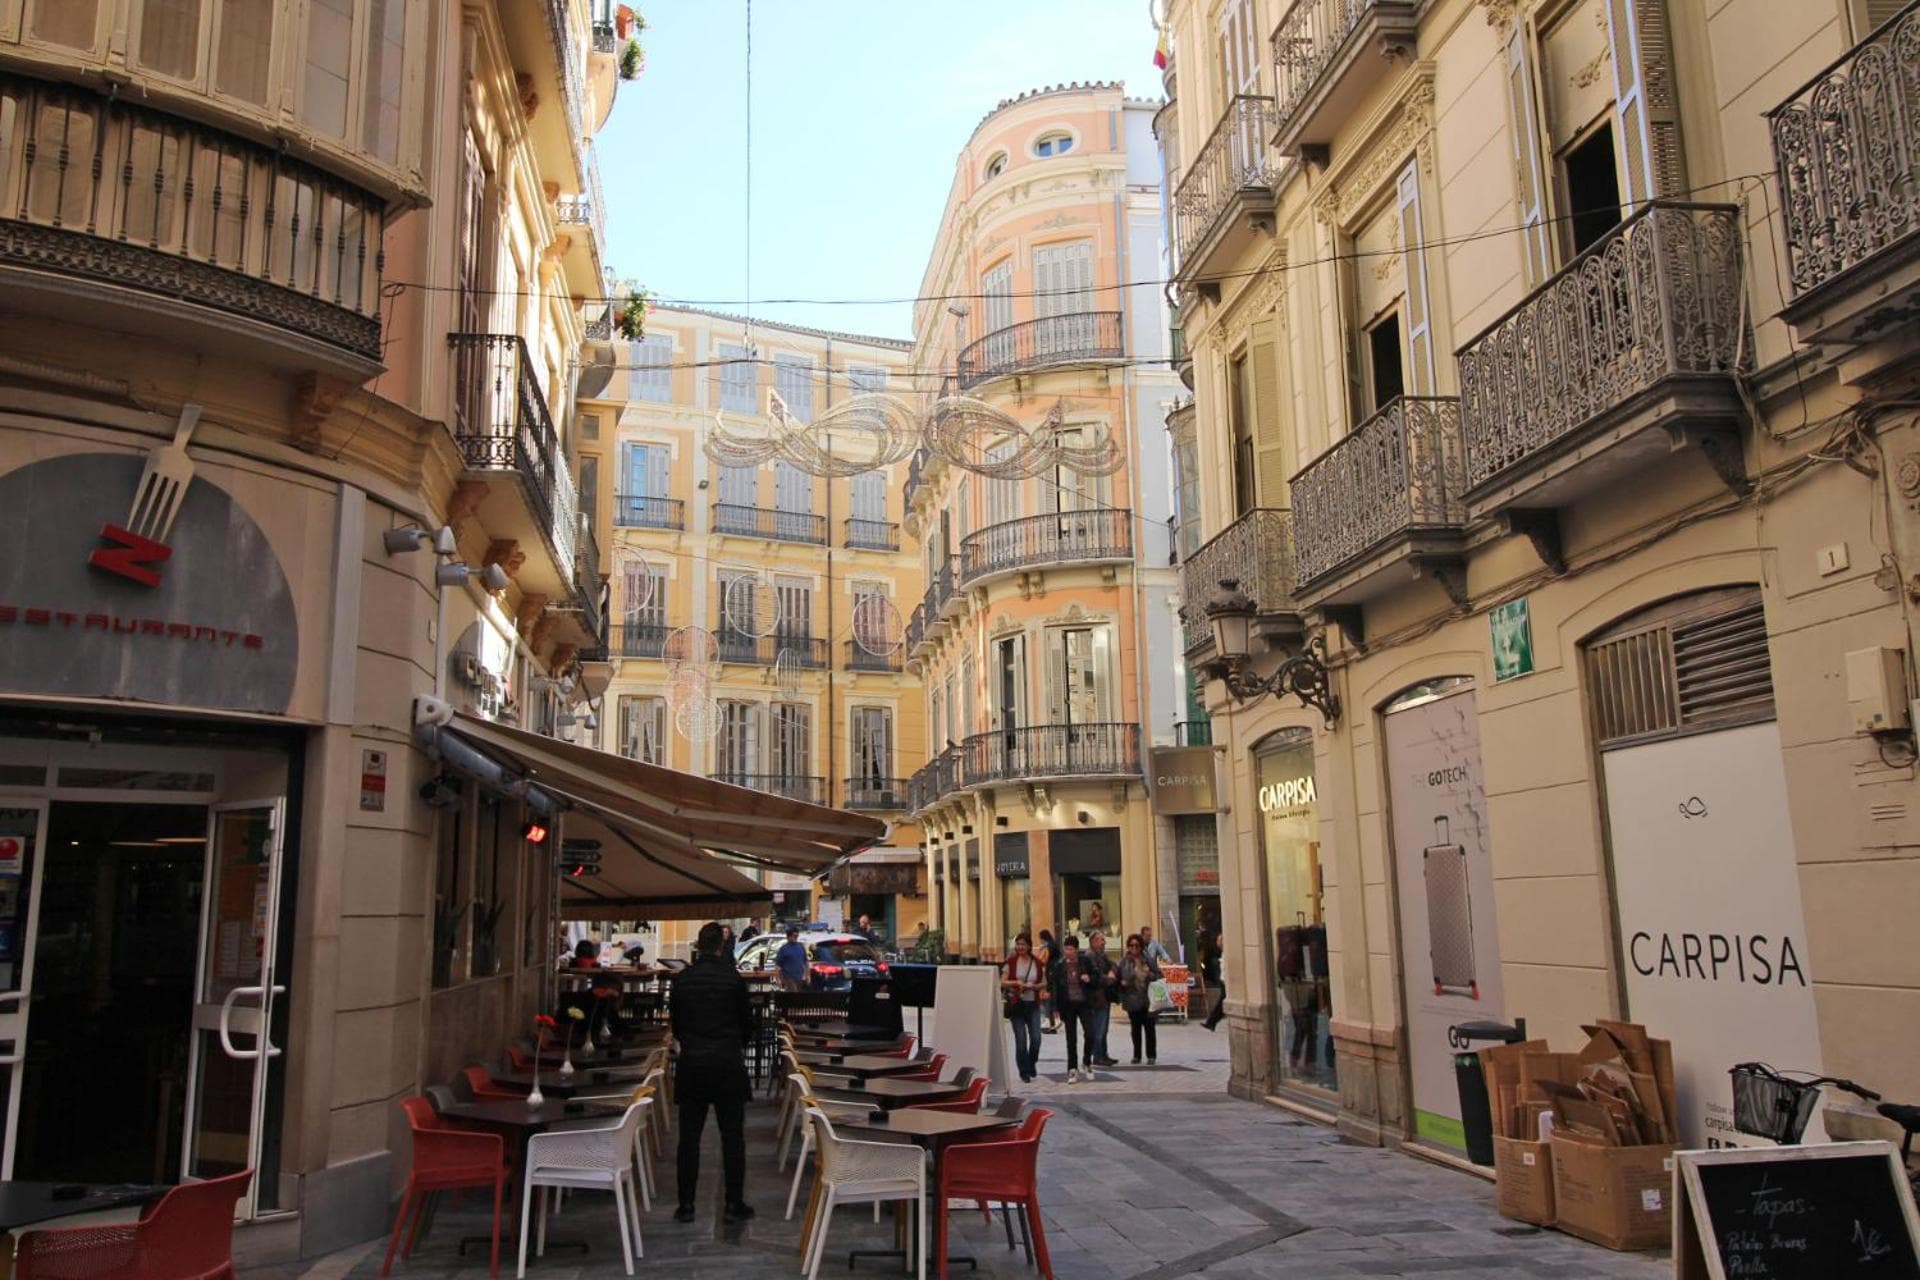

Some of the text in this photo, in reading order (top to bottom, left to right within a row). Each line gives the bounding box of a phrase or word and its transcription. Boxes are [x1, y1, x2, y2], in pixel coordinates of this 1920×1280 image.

[1828, 550, 1836, 568] 1
[1157, 775, 1207, 787] CARPISA
[1259, 775, 1317, 813] CARPISA
[1630, 931, 1807, 987] CARPISA
